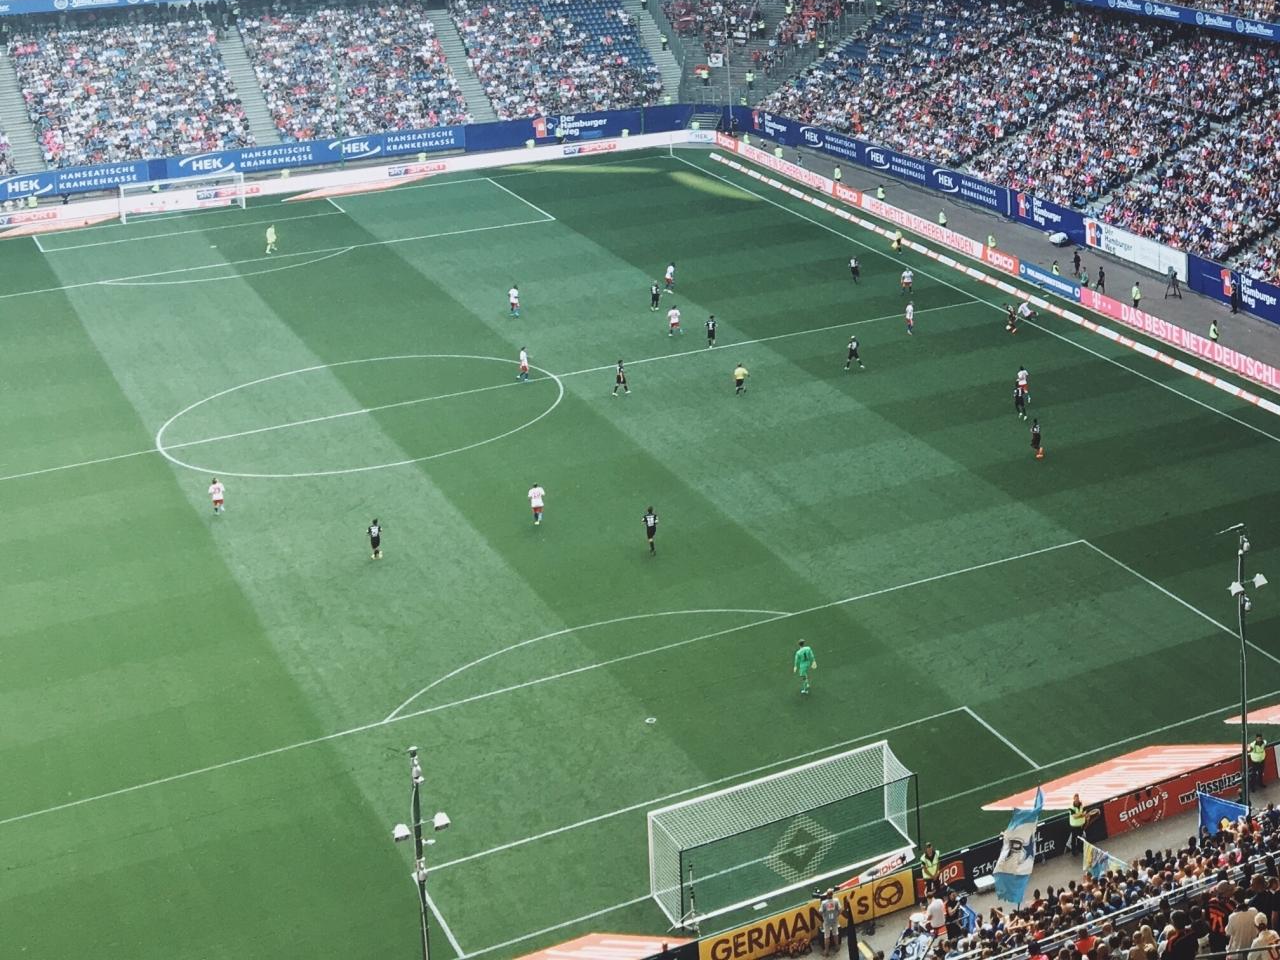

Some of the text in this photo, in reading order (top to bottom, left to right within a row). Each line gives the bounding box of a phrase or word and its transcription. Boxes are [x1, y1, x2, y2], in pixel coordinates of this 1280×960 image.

[560, 115, 576, 123] Der
[560, 119, 608, 131] Hamburger
[387, 130, 453, 143] HANSEATISCHE
[805, 130, 819, 144] HEK
[241, 145, 311, 159] HANSEATISCHE
[342, 141, 370, 154] HEK
[386, 138, 455, 152] KRANKENKASSE
[192, 157, 223, 171] HEK
[240, 153, 313, 168] KRANKENKASSE
[870, 152, 885, 165] HEK
[891, 156, 926, 172] HANSEATISCHE
[60, 165, 135, 180] HANSEATISCHE
[891, 165, 927, 182] KRANKENKASSE
[7, 179, 40, 193] HEK
[59, 174, 137, 189] KRANKENKASSE
[938, 173, 954, 189] HEK
[961, 179, 997, 197] HANSEATISCHE
[960, 188, 999, 208] KRANKENKASSE
[869, 199, 885, 214] IHRE
[885, 205, 905, 224] WETTE
[912, 218, 945, 244] SICHEREN
[986, 249, 1014, 270] tipico
[1240, 274, 1252, 287] Der
[1241, 285, 1277, 306] Hamburger
[1241, 294, 1256, 309] Weg
[1121, 304, 1142, 328] DAS
[1144, 313, 1180, 344] BESTE
[1181, 328, 1214, 358] NETZ
[1119, 791, 1169, 822] Smiley's
